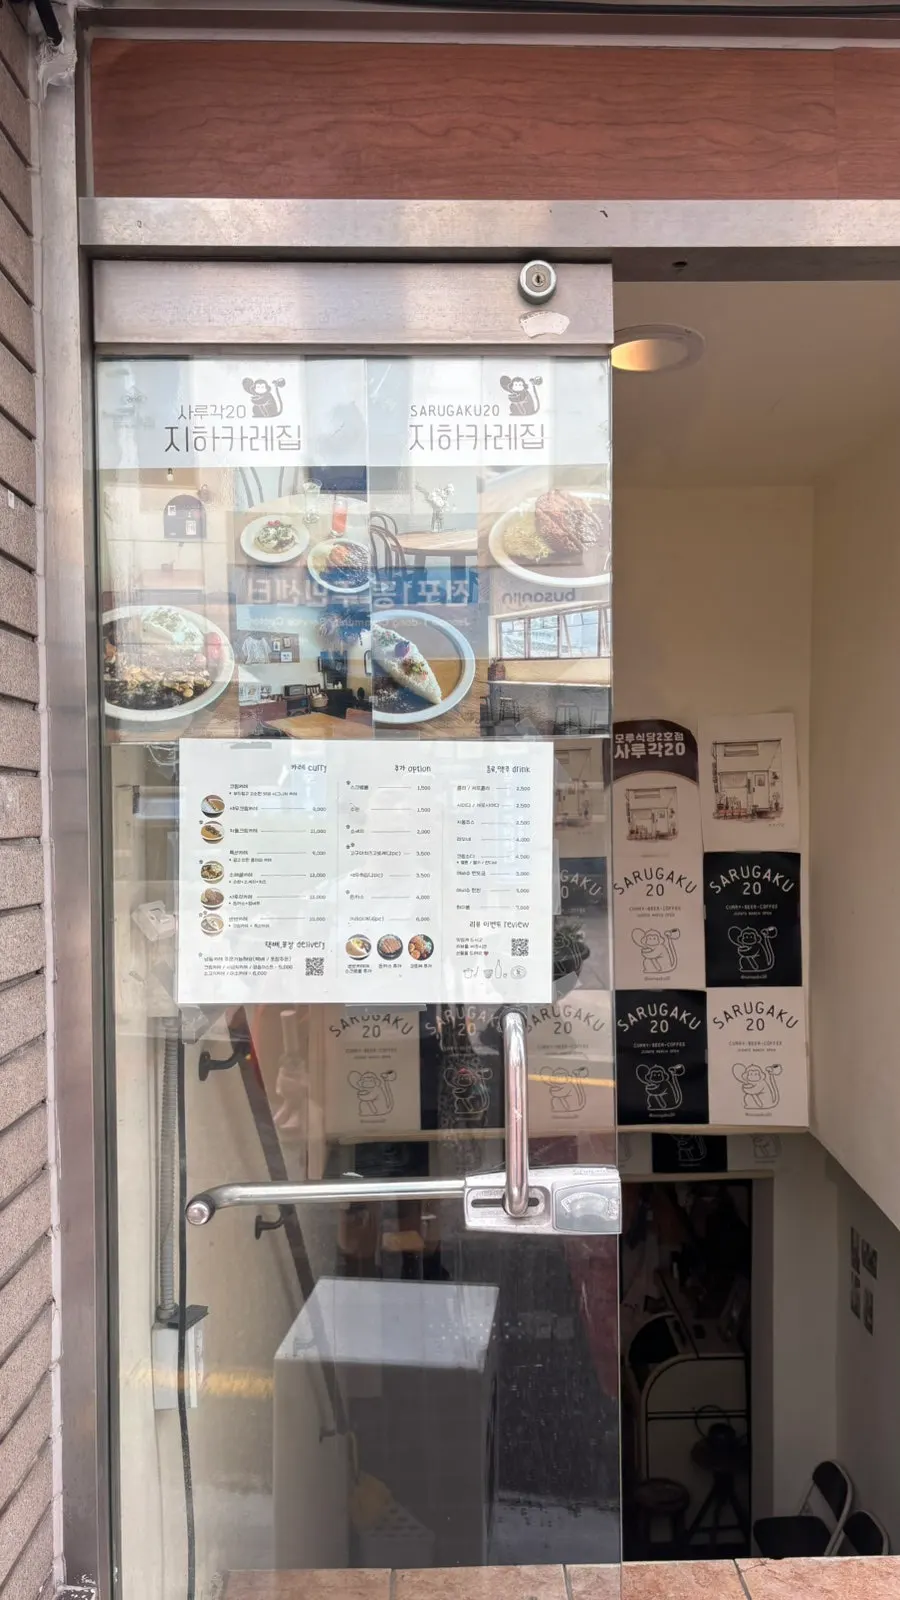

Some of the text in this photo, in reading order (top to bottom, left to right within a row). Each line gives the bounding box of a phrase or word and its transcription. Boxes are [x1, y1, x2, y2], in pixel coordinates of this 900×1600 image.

[178, 404, 246, 420] 사루각20
[410, 404, 500, 417] SARUGAKU20
[164, 425, 301, 452] 지하카레집
[409, 423, 544, 451] 지하카레집
[614, 731, 684, 744] 모루식당2호점
[614, 742, 686, 759] 사루각20
[408, 765, 431, 773] option
[512, 765, 531, 773] drink
[613, 867, 697, 895] SARUGAKU
[709, 865, 794, 894] SARUGAKU
[646, 884, 665, 896] 20
[742, 881, 761, 895] 20
[617, 1002, 701, 1032] SARUGAKU
[713, 1001, 799, 1030] SARUGAKU
[458, 1023, 476, 1036] 20
[553, 1021, 572, 1034] 20
[650, 1020, 669, 1033] 20
[745, 1018, 765, 1031] 20
[362, 1025, 381, 1038] 20
